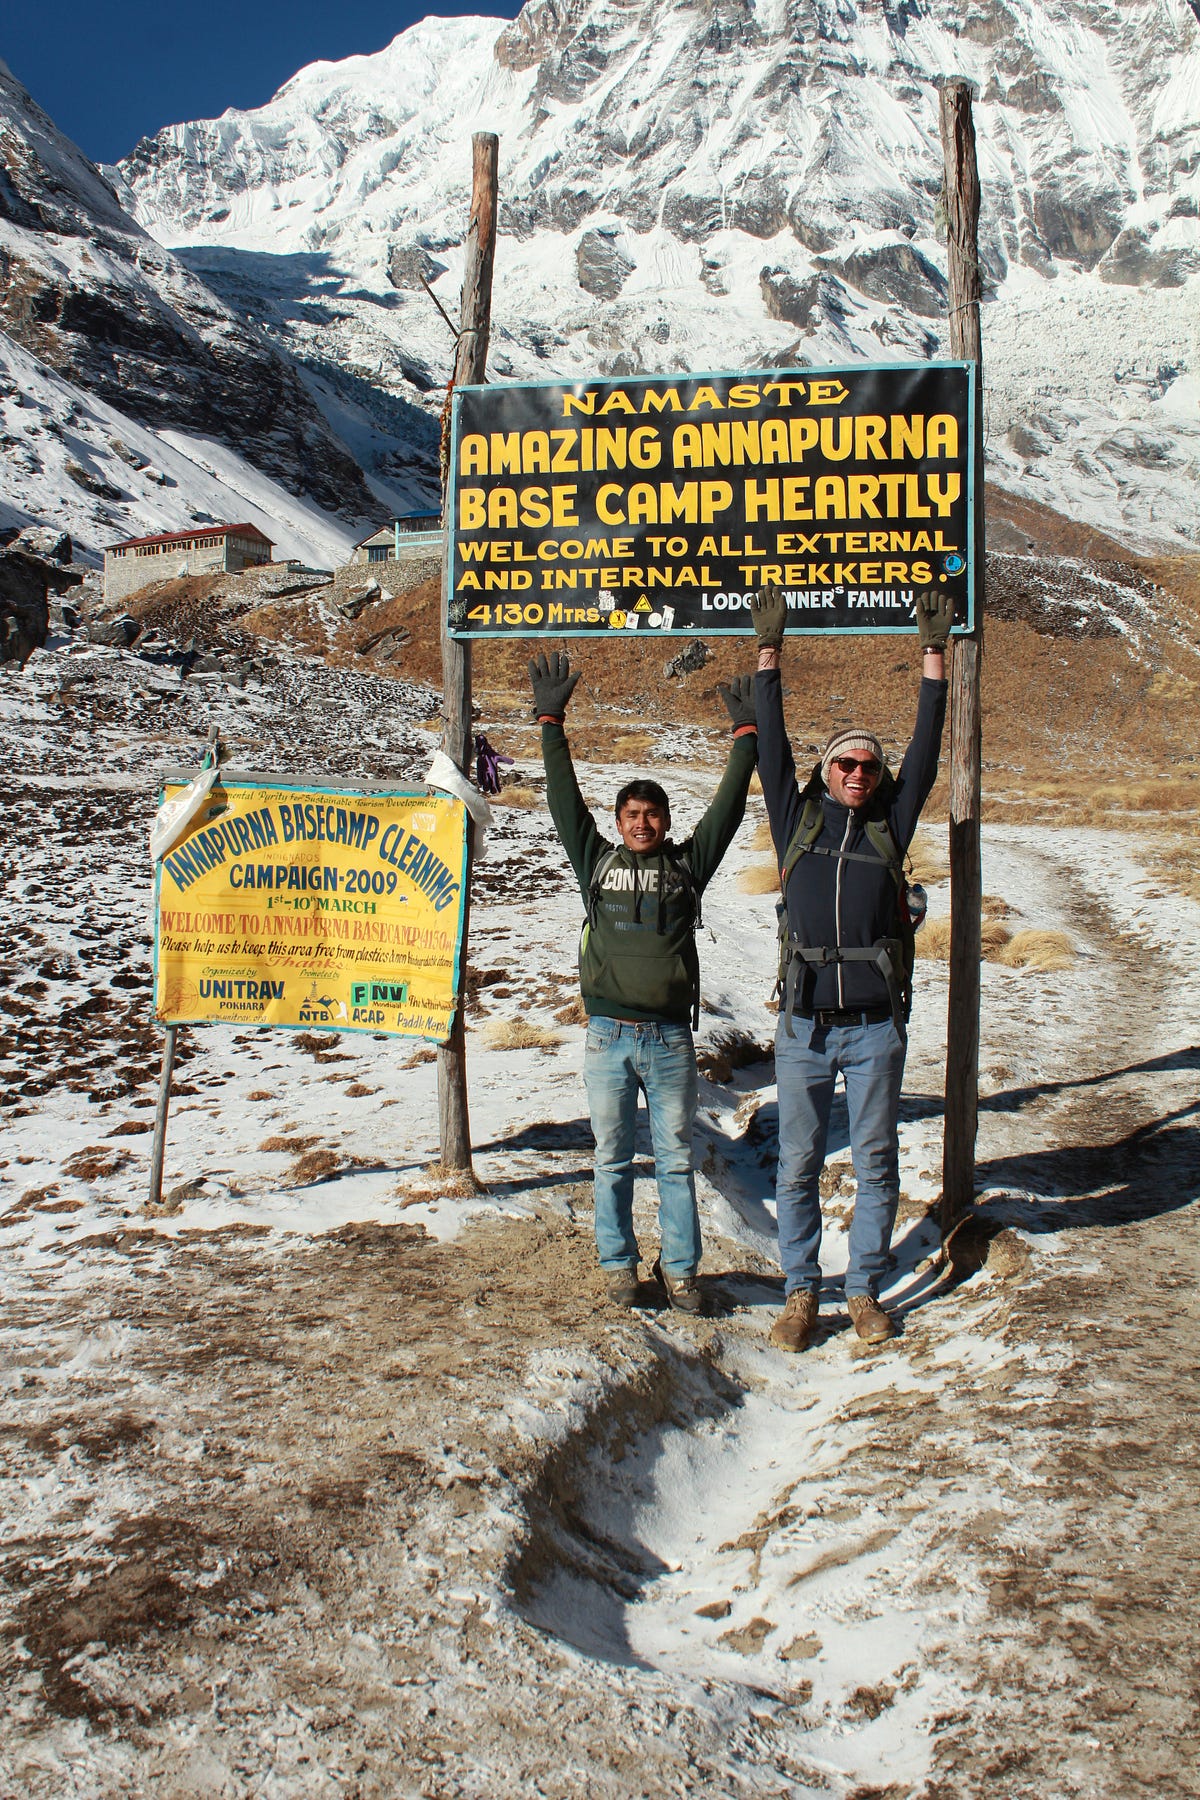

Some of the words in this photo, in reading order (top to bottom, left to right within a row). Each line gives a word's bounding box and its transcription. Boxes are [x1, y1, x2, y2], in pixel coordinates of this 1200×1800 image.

[562, 380, 850, 417] NAMASTE
[460, 426, 662, 476] AMAZING
[672, 414, 959, 468] ANNAPURNA
[459, 485, 580, 530] BASE
[595, 480, 733, 526] CAMP
[744, 472, 961, 523] HEARTLY
[458, 538, 635, 562] WELCOME
[646, 537, 688, 557] TO
[696, 535, 767, 557] ALL
[776, 530, 958, 554] EXTERNAL
[456, 570, 533, 591] AND
[541, 565, 722, 590] INTERNAL
[738, 561, 947, 587] TREKKERS.
[467, 604, 544, 625] 4130
[702, 592, 760, 611] LODG
[847, 590, 914, 609] FAMILY
[258, 791, 288, 803] Purity
[354, 799, 385, 808] Tourism
[164, 808, 279, 893] ANNAPURNA
[279, 803, 380, 851] BASECAMP
[379, 823, 460, 913] CLEANING
[230, 864, 398, 896] CAMPAIGN-2009
[316, 897, 377, 914] MARCH
[161, 911, 236, 935] WELCOME
[239, 914, 260, 935] TO
[261, 915, 349, 940] ANNAPURNA
[352, 920, 420, 947] BASECAMP
[161, 935, 192, 952] Please
[194, 938, 215, 956] help
[216, 943, 231, 954] us
[231, 940, 241, 954] to
[241, 940, 266, 957] keep
[268, 940, 287, 956] this
[287, 945, 313, 957] area
[313, 942, 336, 958] free
[334, 944, 355, 960] from
[355, 947, 389, 963] plastics
[202, 966, 245, 977] Organized
[219, 1001, 265, 1011] POKHARA
[299, 1010, 329, 1022] NTB
